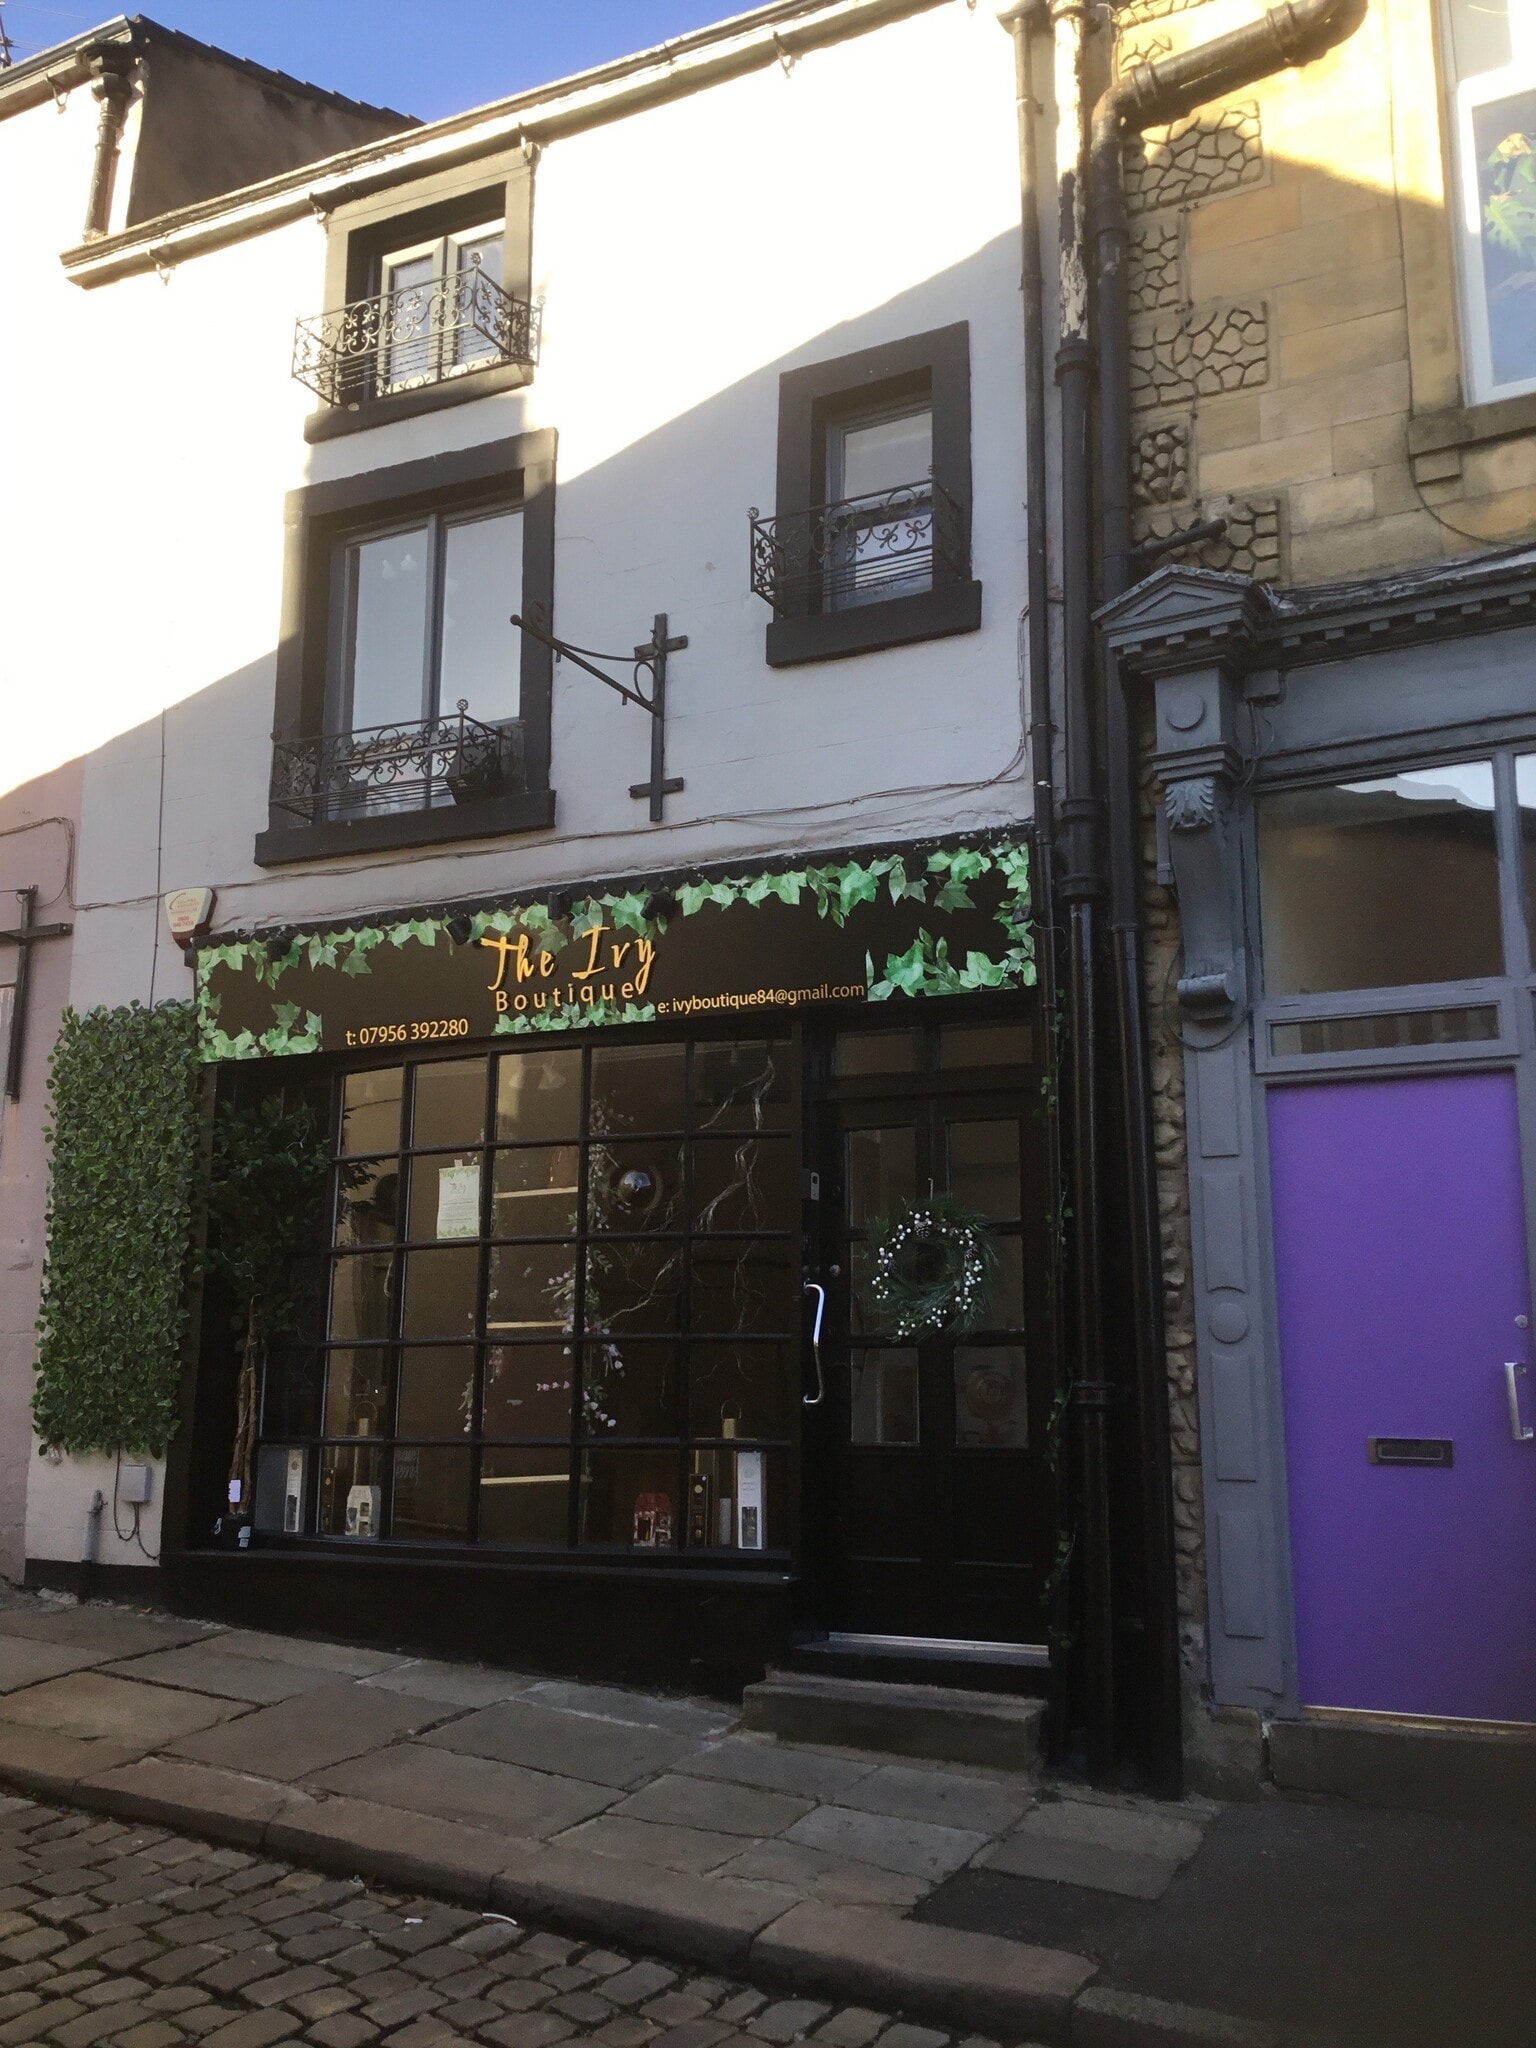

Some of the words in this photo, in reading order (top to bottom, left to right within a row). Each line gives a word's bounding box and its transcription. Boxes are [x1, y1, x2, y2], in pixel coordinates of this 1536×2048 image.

[480, 933, 555, 991] The
[572, 924, 656, 995] Ivy
[495, 982, 634, 1012] Boutique
[672, 984, 865, 1014] ivyboutique84@gmail.com
[345, 1030, 356, 1046] t:
[359, 1024, 407, 1045] 07956
[410, 1018, 469, 1040] 392280
